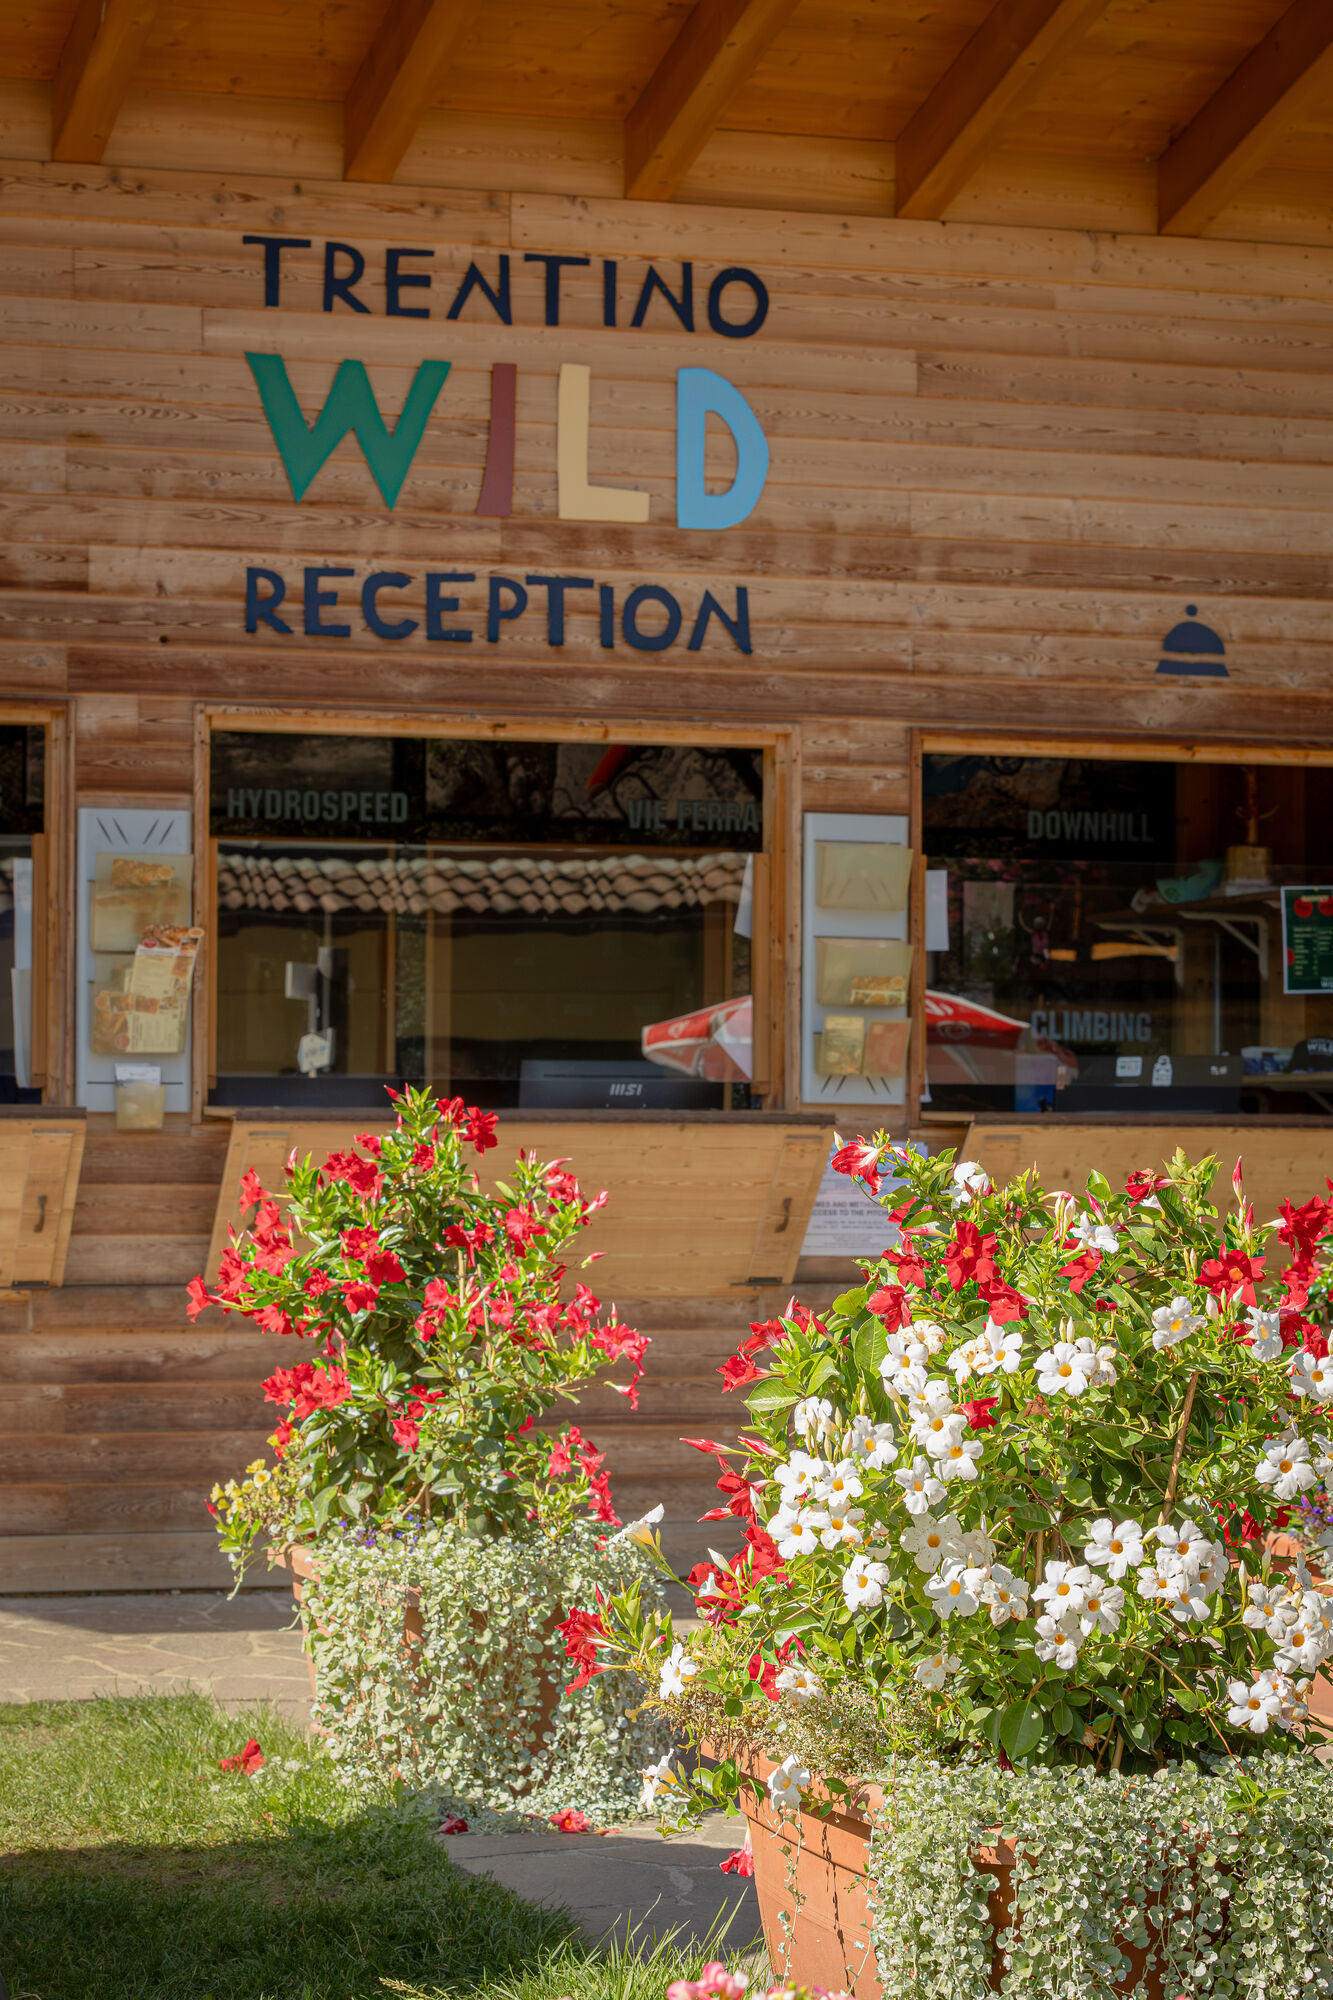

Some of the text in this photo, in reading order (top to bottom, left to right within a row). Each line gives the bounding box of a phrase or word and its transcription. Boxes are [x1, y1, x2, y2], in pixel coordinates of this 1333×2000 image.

[243, 235, 769, 338] TRENTINO
[244, 351, 770, 530] WILD
[246, 567, 753, 656] RECEPTION
[227, 787, 409, 823] HYDROSPEED
[627, 799, 762, 832] VIE FERRA
[1027, 811, 1154, 842] DOWNHILL
[1031, 1010, 1152, 1042] CLIMBING
